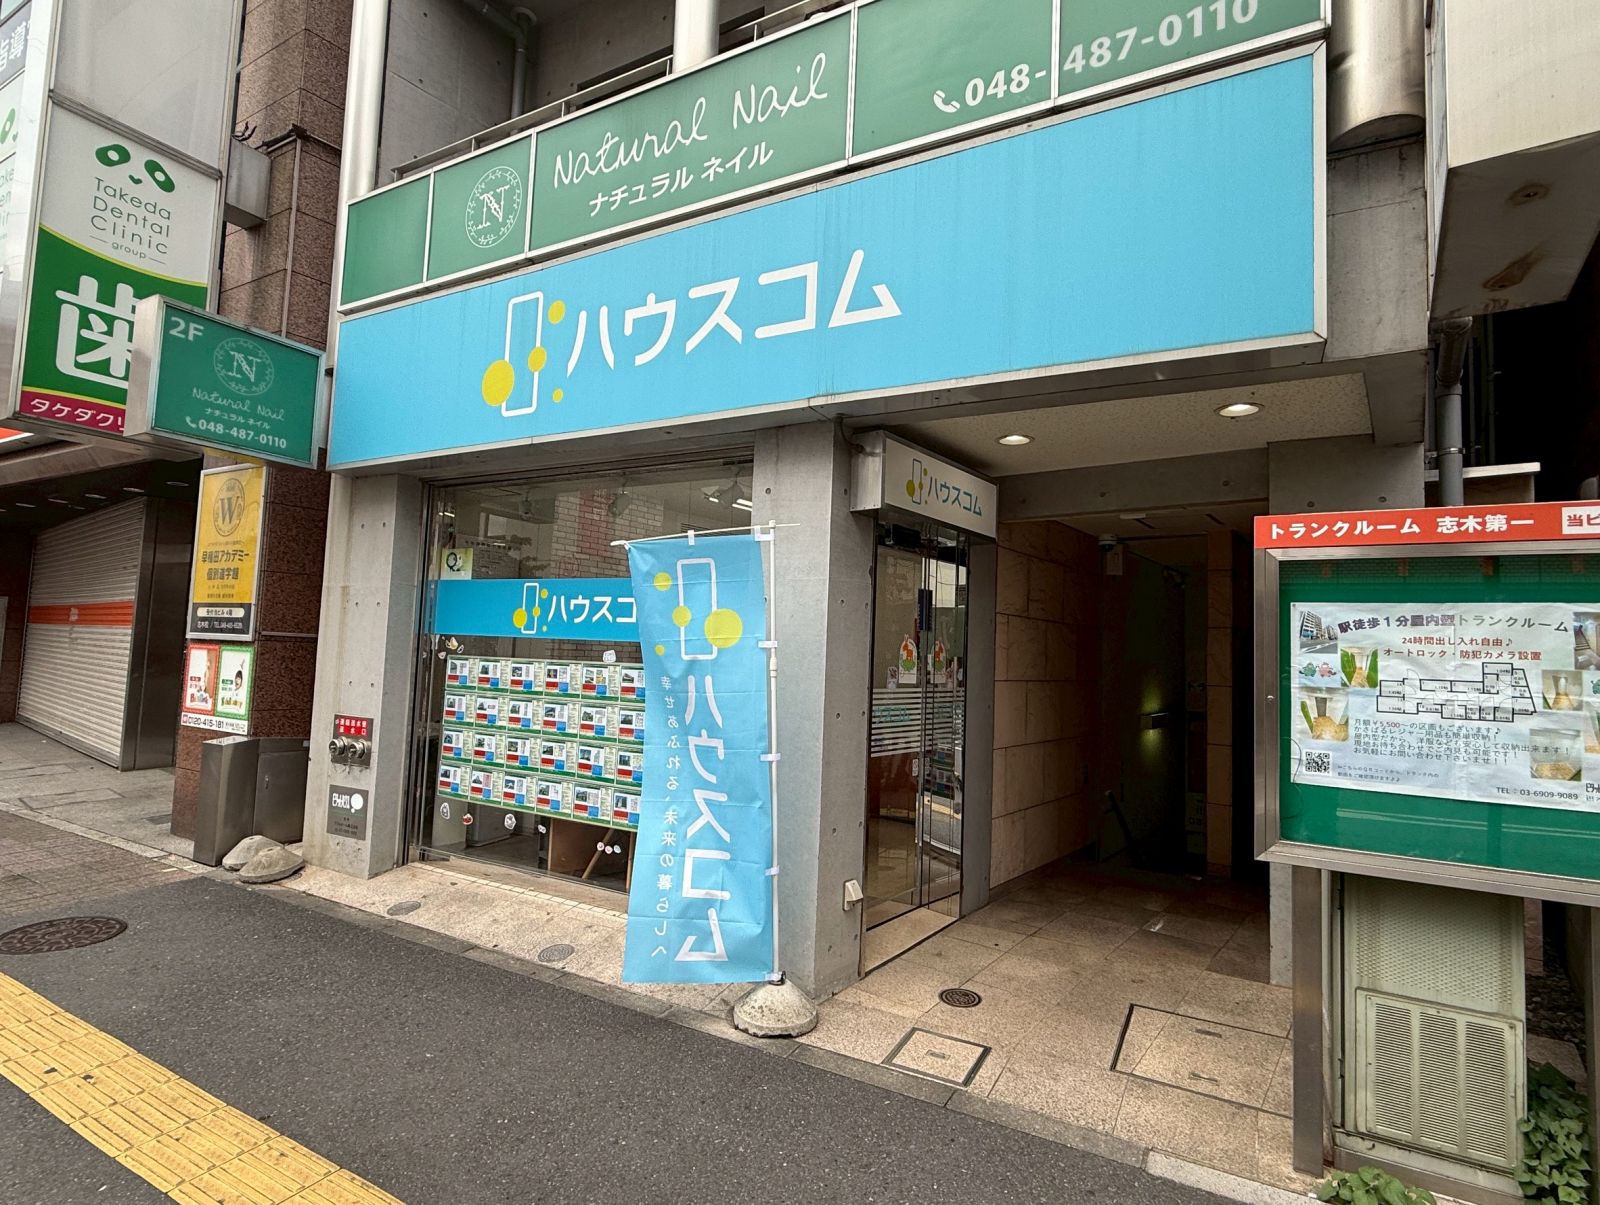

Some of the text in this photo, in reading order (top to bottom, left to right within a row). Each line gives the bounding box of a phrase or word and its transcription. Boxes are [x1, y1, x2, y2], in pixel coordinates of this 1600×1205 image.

[964, 0, 1259, 107] 048- 487-0110
[553, 52, 828, 189] Natural Nail
[589, 141, 775, 217] ナチュラル ネイル
[95, 177, 171, 220] Takeda
[93, 195, 169, 238] Dental
[91, 215, 168, 254] Clinic
[112, 242, 146, 259] group
[566, 249, 903, 378] ハウスコム
[168, 316, 204, 342] 2F
[192, 387, 286, 421] Natural Nail
[205, 408, 271, 429] ナチュラル ネイル
[198, 419, 287, 449] 048-487-0110
[219, 495, 240, 525] W
[927, 476, 983, 517] ハウスコム
[1271, 514, 1535, 539] トランクルーム 志木第一
[202, 549, 250, 564] 早稲田アカデミー
[548, 594, 637, 624] ハウスコ
[1338, 614, 1569, 634] 駅徒歩1分屋内型トランクルーム
[1384, 648, 1542, 661] オートロック・防犯カメラ設置
